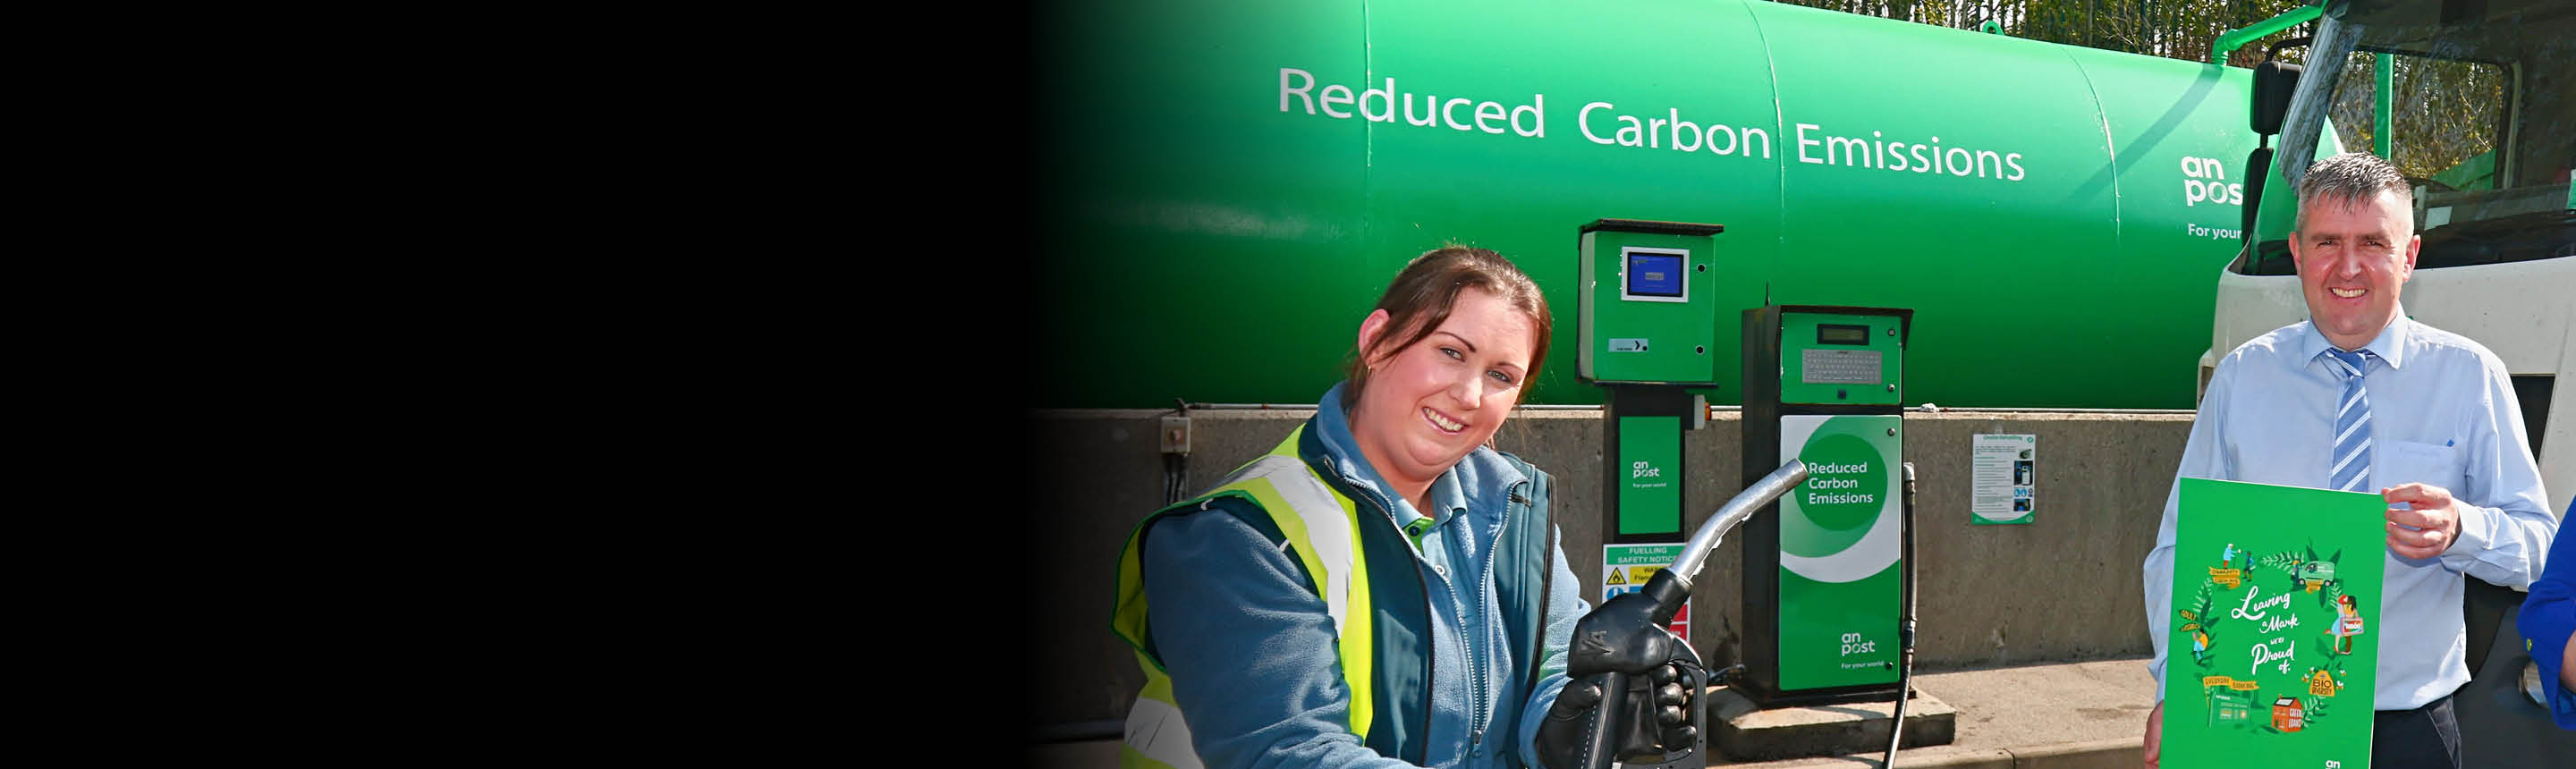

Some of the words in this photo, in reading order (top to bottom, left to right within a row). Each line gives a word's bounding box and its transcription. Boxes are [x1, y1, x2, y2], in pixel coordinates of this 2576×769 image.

[1279, 67, 1545, 139] Reduced
[1578, 101, 1771, 159] Carbon
[1795, 123, 2026, 182] Emissions
[2181, 156, 2224, 180] an
[2183, 179, 2244, 207] pos
[2188, 224, 2210, 237] For
[2212, 228, 2242, 240] your
[1632, 461, 1648, 469] an
[1809, 461, 1868, 474] Reduced
[1632, 468, 1661, 478] post
[1809, 477, 1859, 490] Carbon
[1809, 492, 1875, 504] Emissions
[1629, 546, 1667, 554] FUELLING
[1617, 555, 1648, 564] SAFETY
[2231, 586, 2291, 621] Leaving
[2258, 613, 2300, 633] Mark
[1841, 632, 1861, 644] an
[1841, 640, 1876, 657] post
[2251, 639, 2295, 675] Proud
[2312, 679, 2332, 689] BIO
[2326, 760, 2341, 769] an
